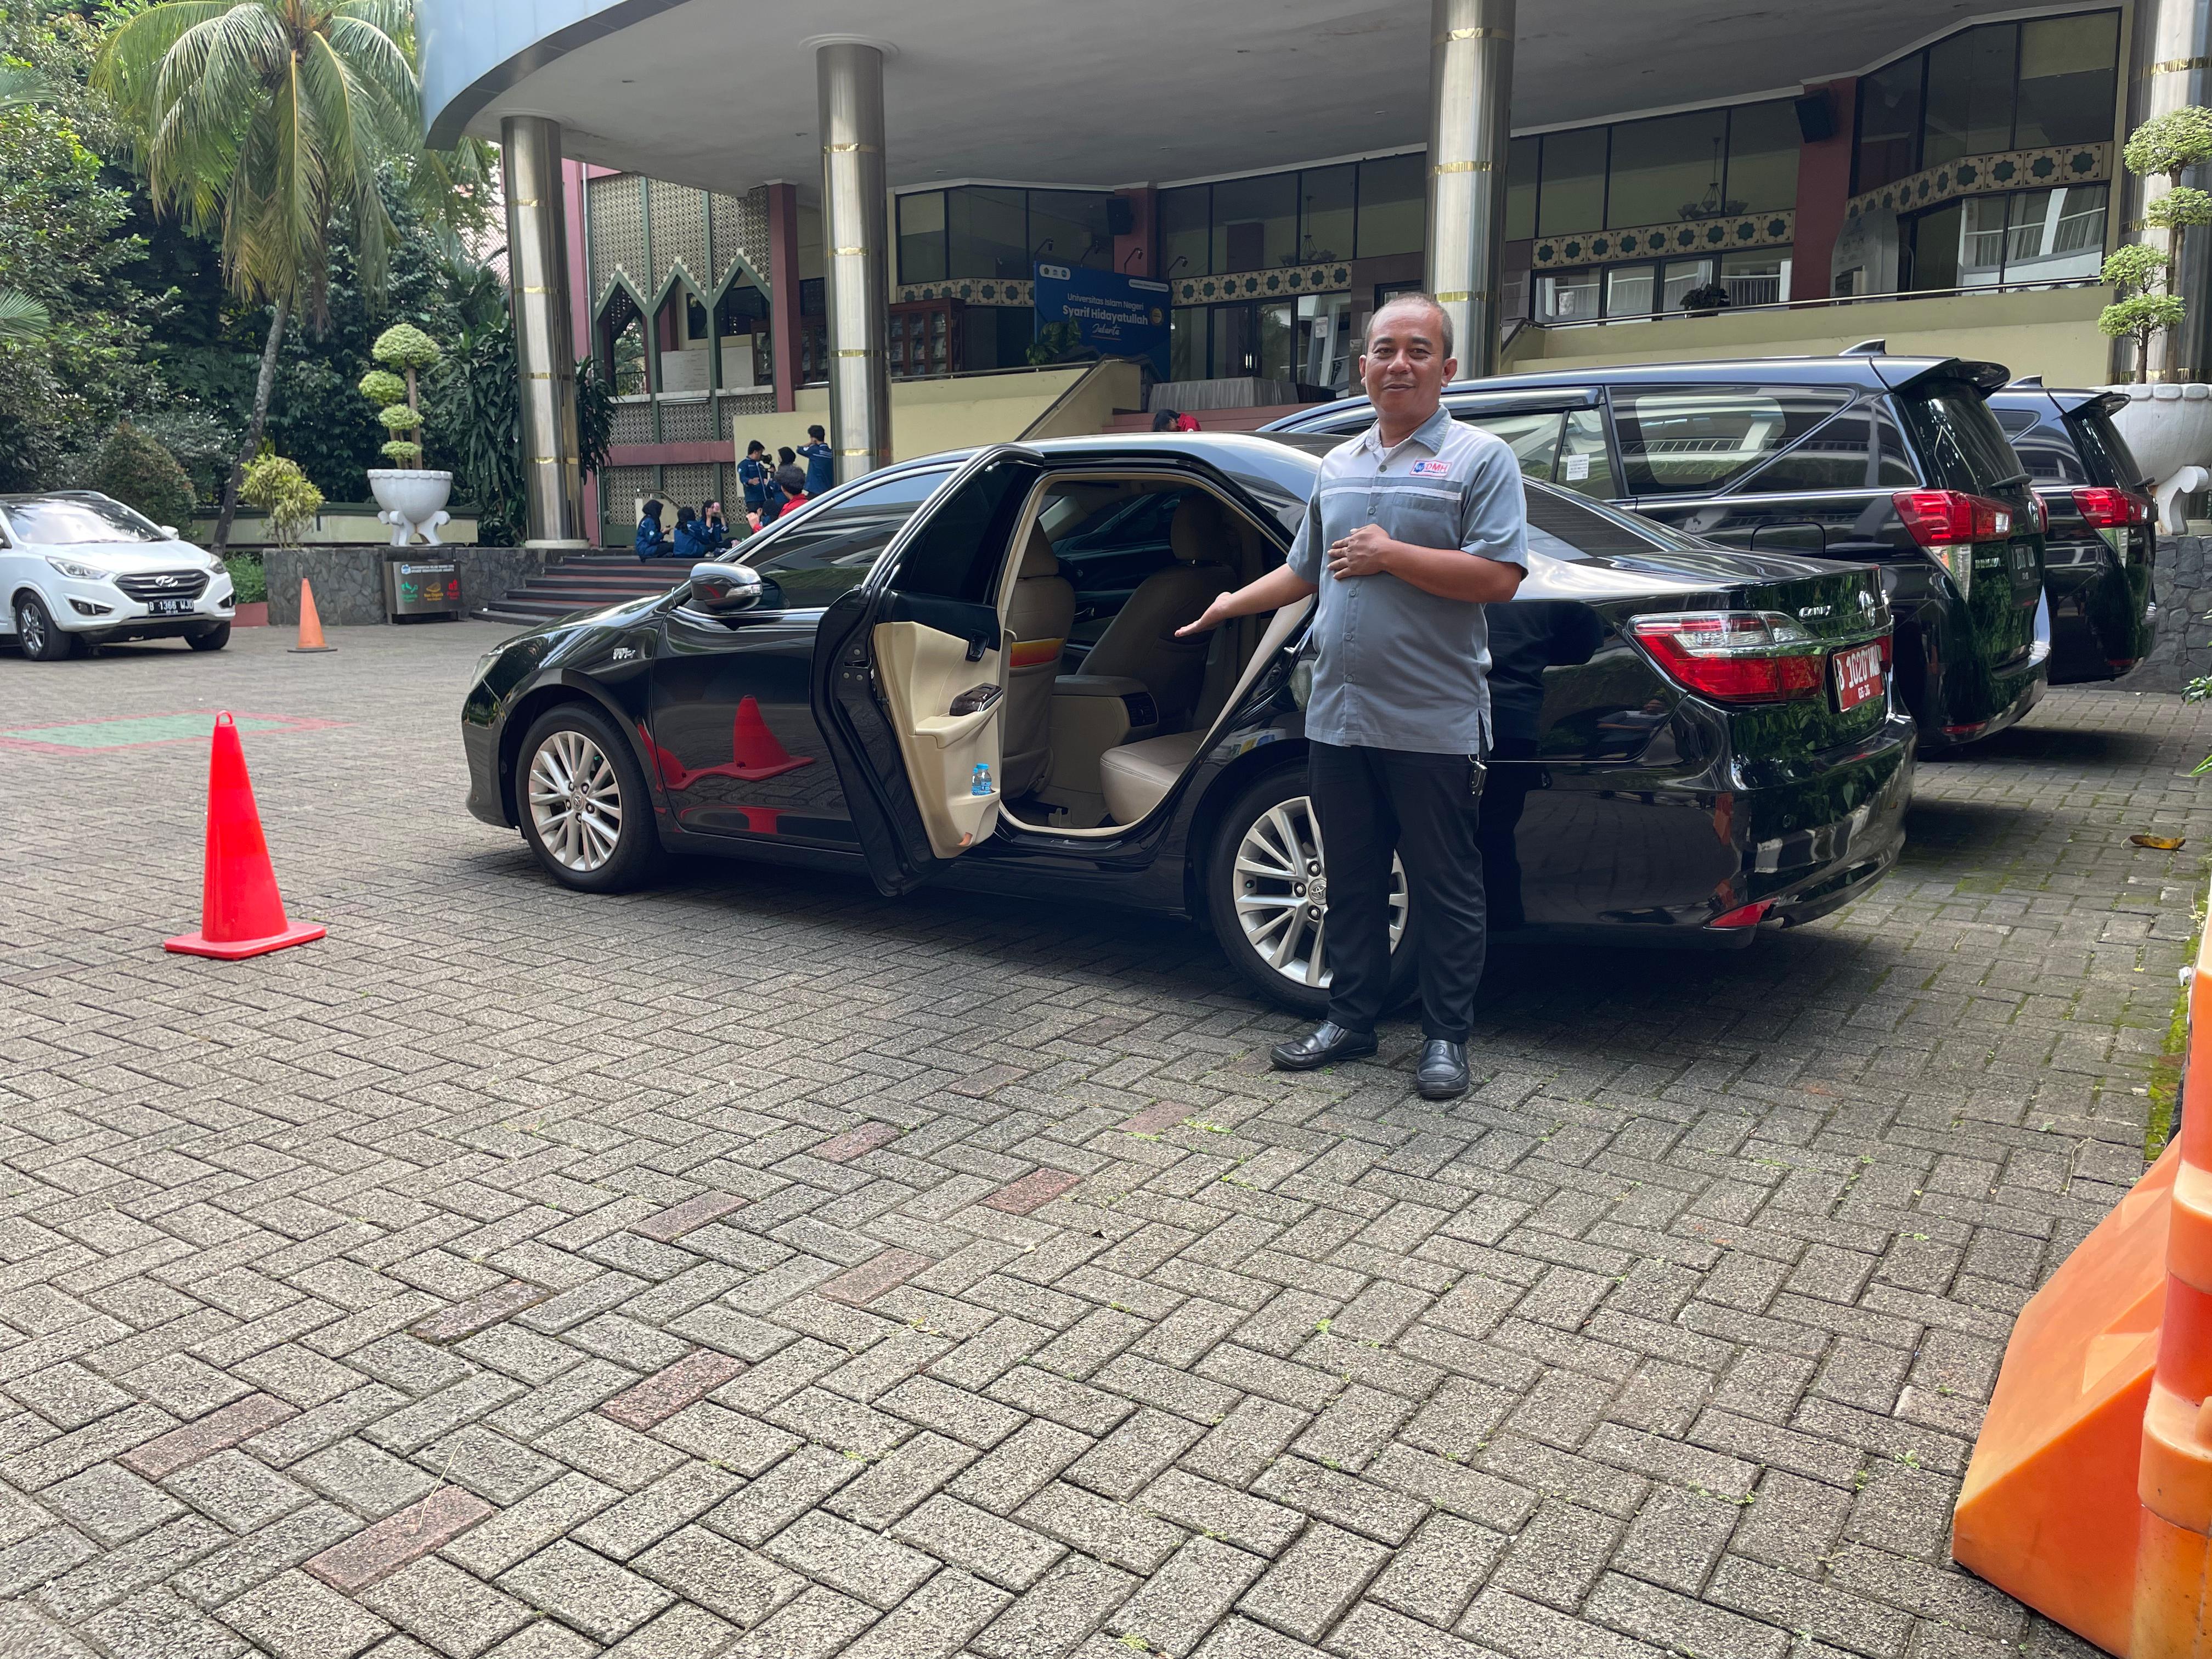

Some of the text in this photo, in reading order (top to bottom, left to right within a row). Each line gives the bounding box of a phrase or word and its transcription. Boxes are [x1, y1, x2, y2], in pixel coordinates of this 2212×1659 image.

[1067, 292, 1144, 312] Universitas Islam Negeri
[1062, 304, 1090, 318] Syarif
[1091, 308, 1148, 325] Hidayatullah
[1092, 323, 1121, 336] Jakarta
[1425, 463, 1448, 472] DMH
[149, 601, 154, 611] B
[1836, 658, 1845, 691] B
[1846, 650, 1868, 689] 1020
